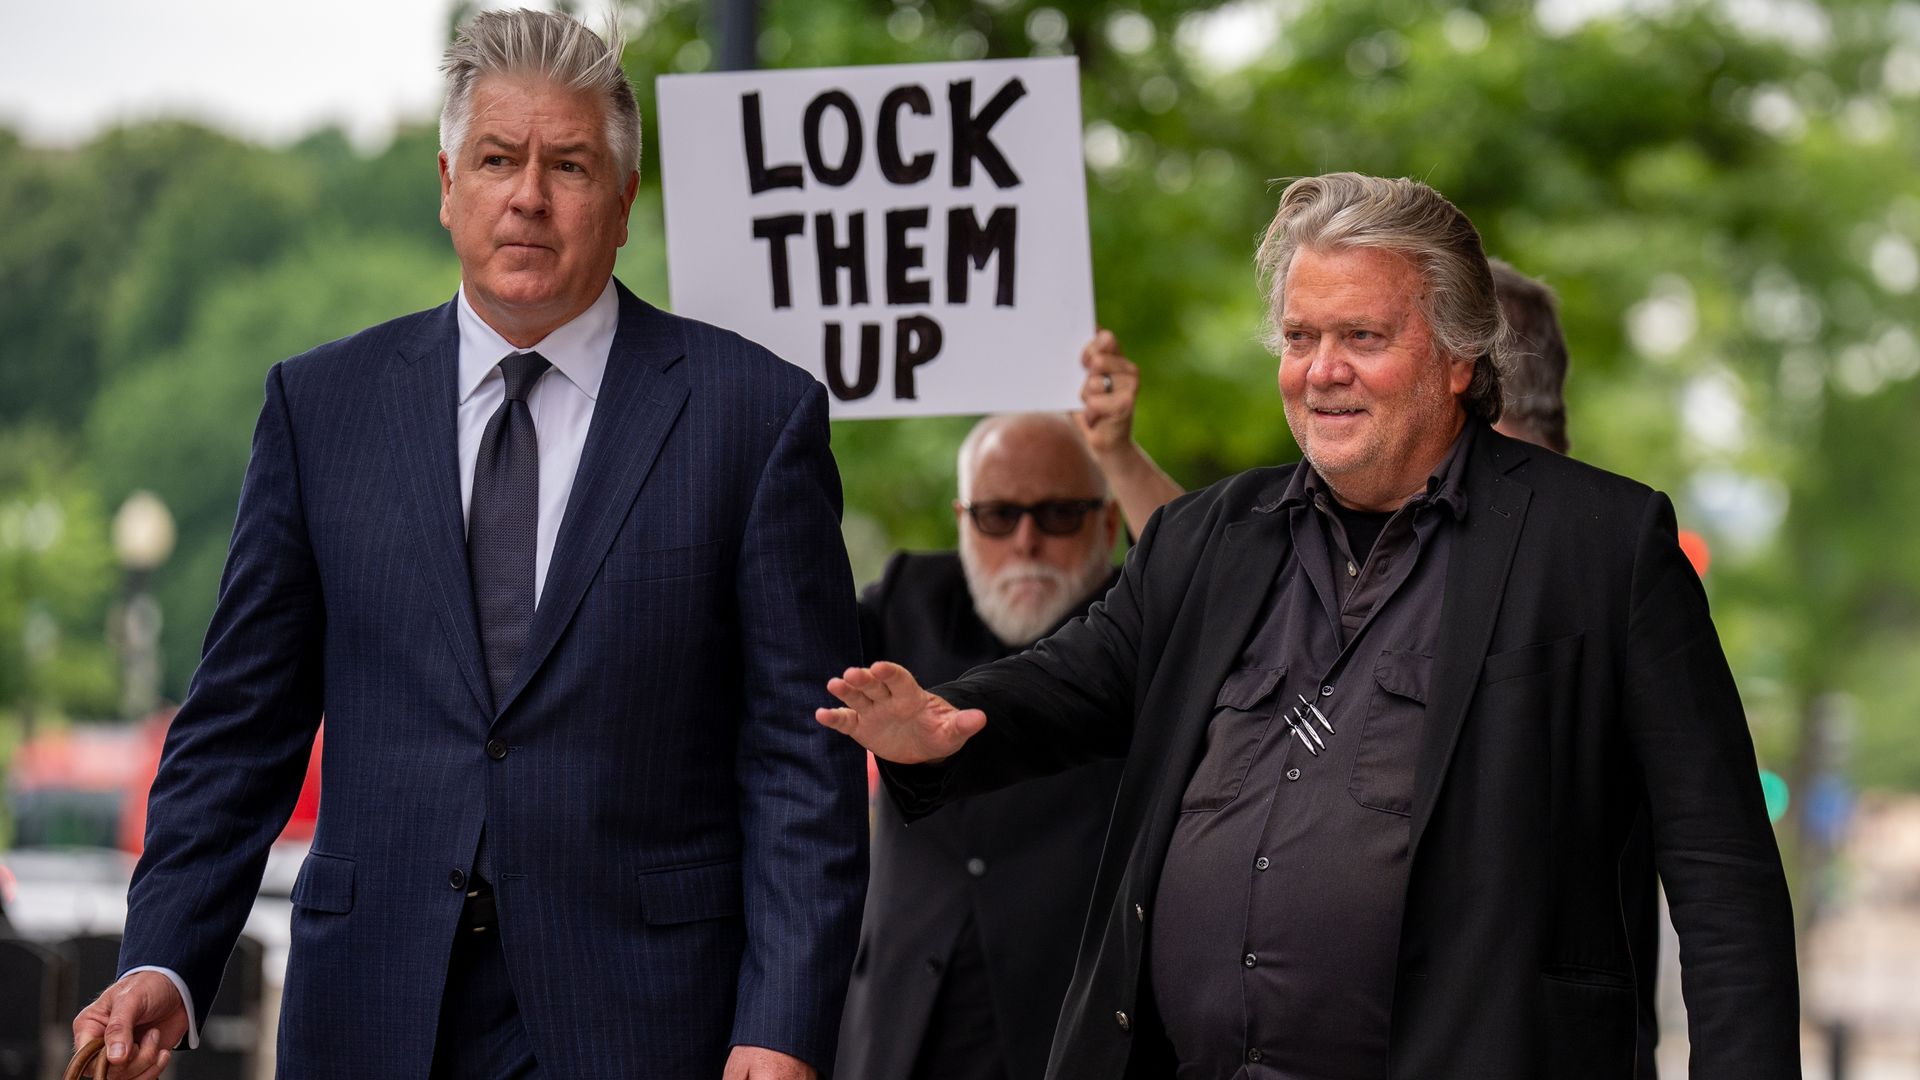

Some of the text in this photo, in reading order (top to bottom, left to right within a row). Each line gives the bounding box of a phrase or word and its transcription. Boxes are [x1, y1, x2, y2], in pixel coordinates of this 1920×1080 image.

[741, 77, 1028, 196] LOCK
[751, 205, 1017, 310] THEM
[823, 313, 943, 402] UP
